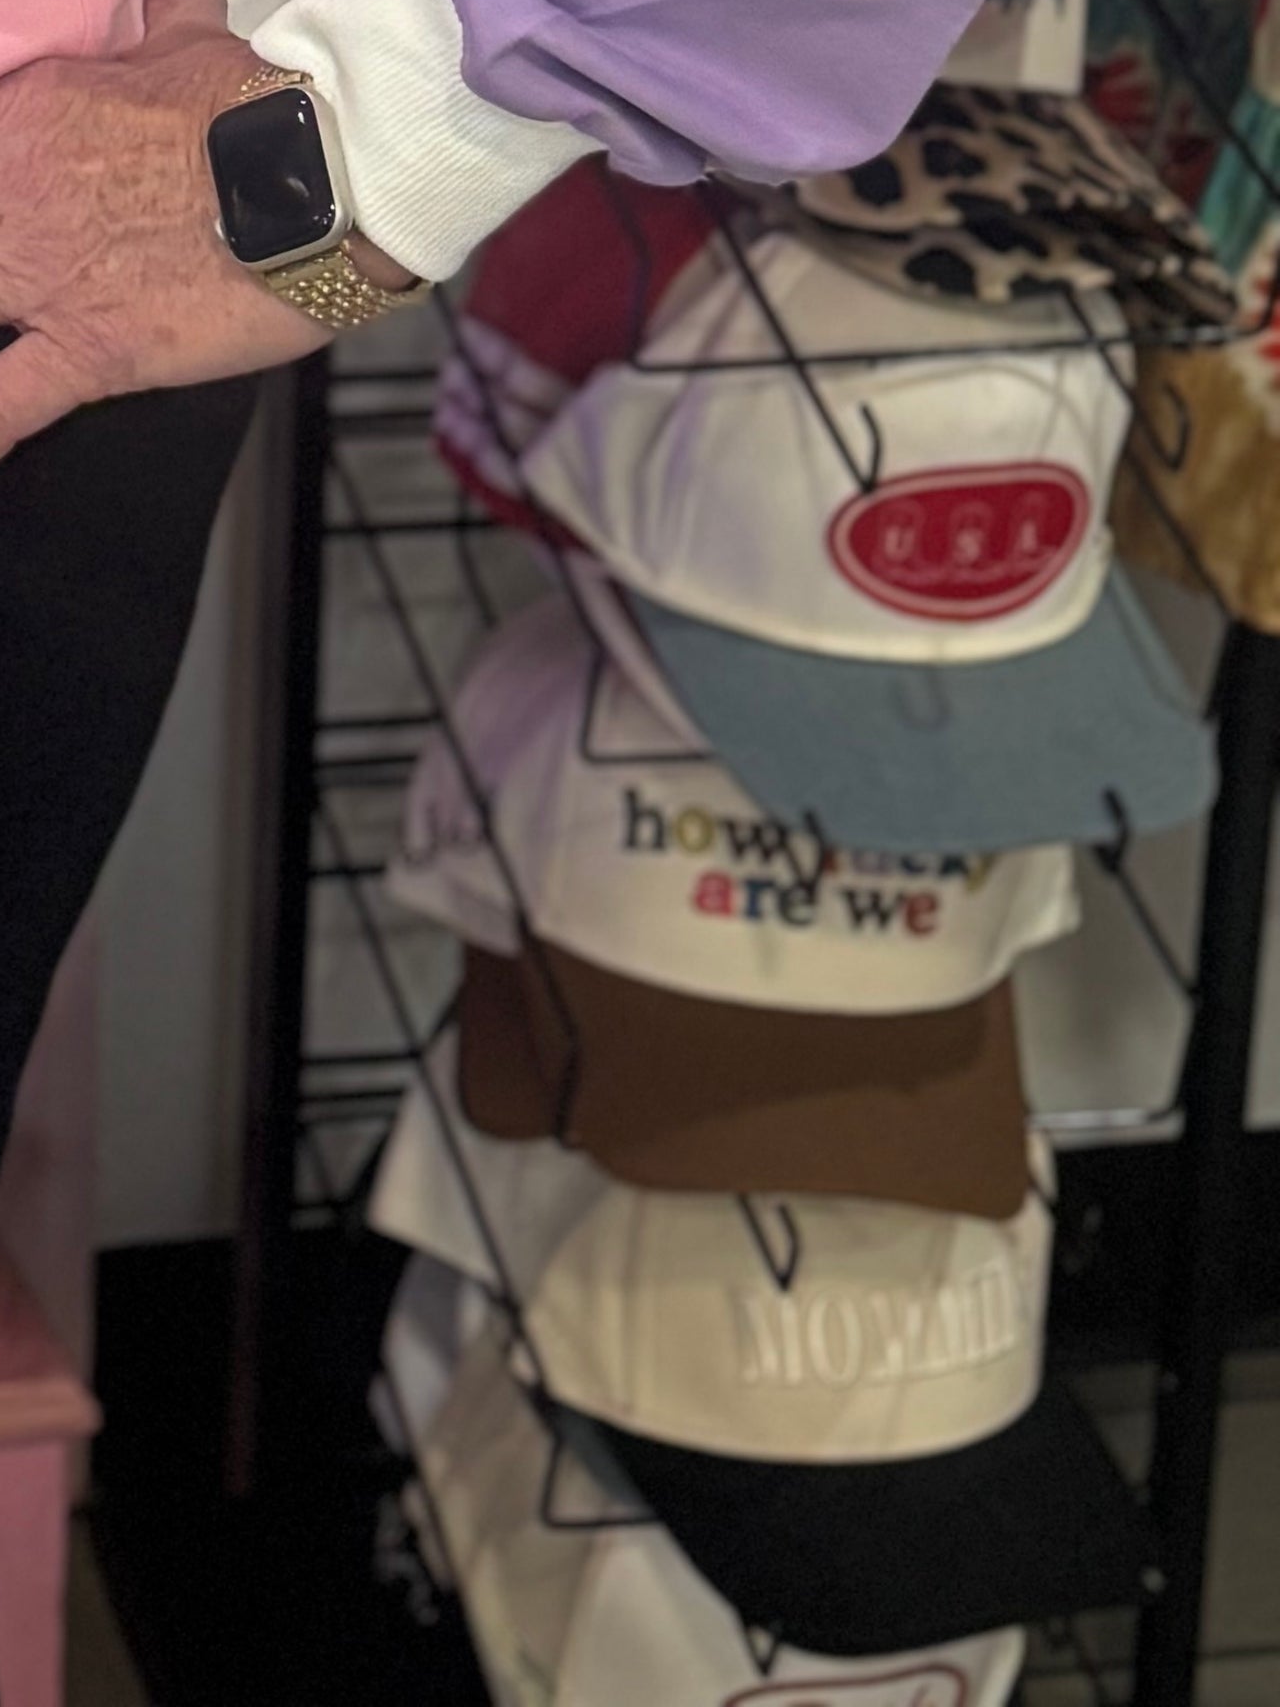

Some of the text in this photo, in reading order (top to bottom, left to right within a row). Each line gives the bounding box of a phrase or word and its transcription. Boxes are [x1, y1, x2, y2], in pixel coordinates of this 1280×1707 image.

[622, 787, 790, 865] how
[692, 869, 940, 938] are we
